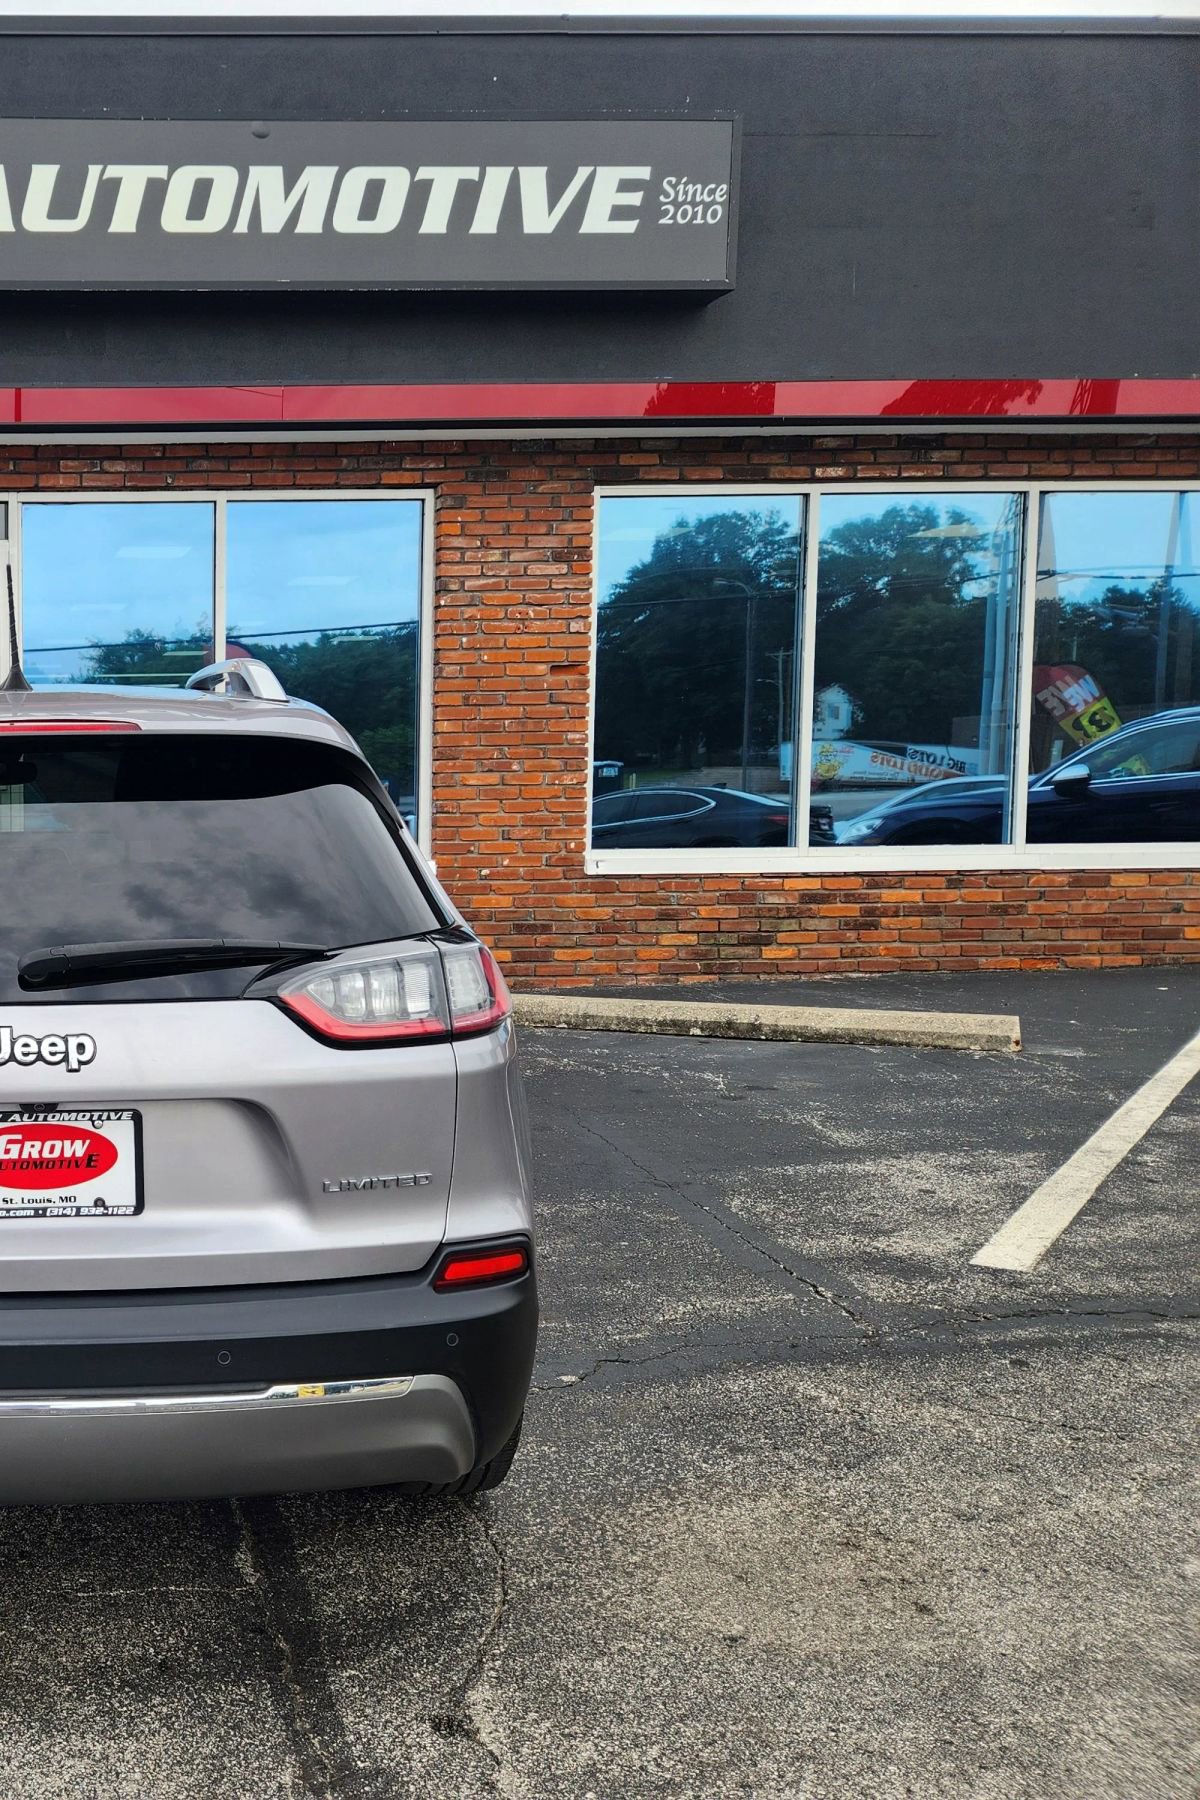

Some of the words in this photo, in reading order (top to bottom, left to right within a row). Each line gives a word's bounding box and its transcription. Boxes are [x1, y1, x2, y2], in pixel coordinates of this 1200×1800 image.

[659, 176, 728, 203] Since
[658, 204, 723, 225] 2010
[7, 1111, 134, 1122] AUTOMOTIVE
[322, 1172, 433, 1193] LIMITED
[58, 1195, 77, 1204] MO
[46, 1206, 77, 1218] (314)
[79, 1205, 135, 1216] 932-1122
